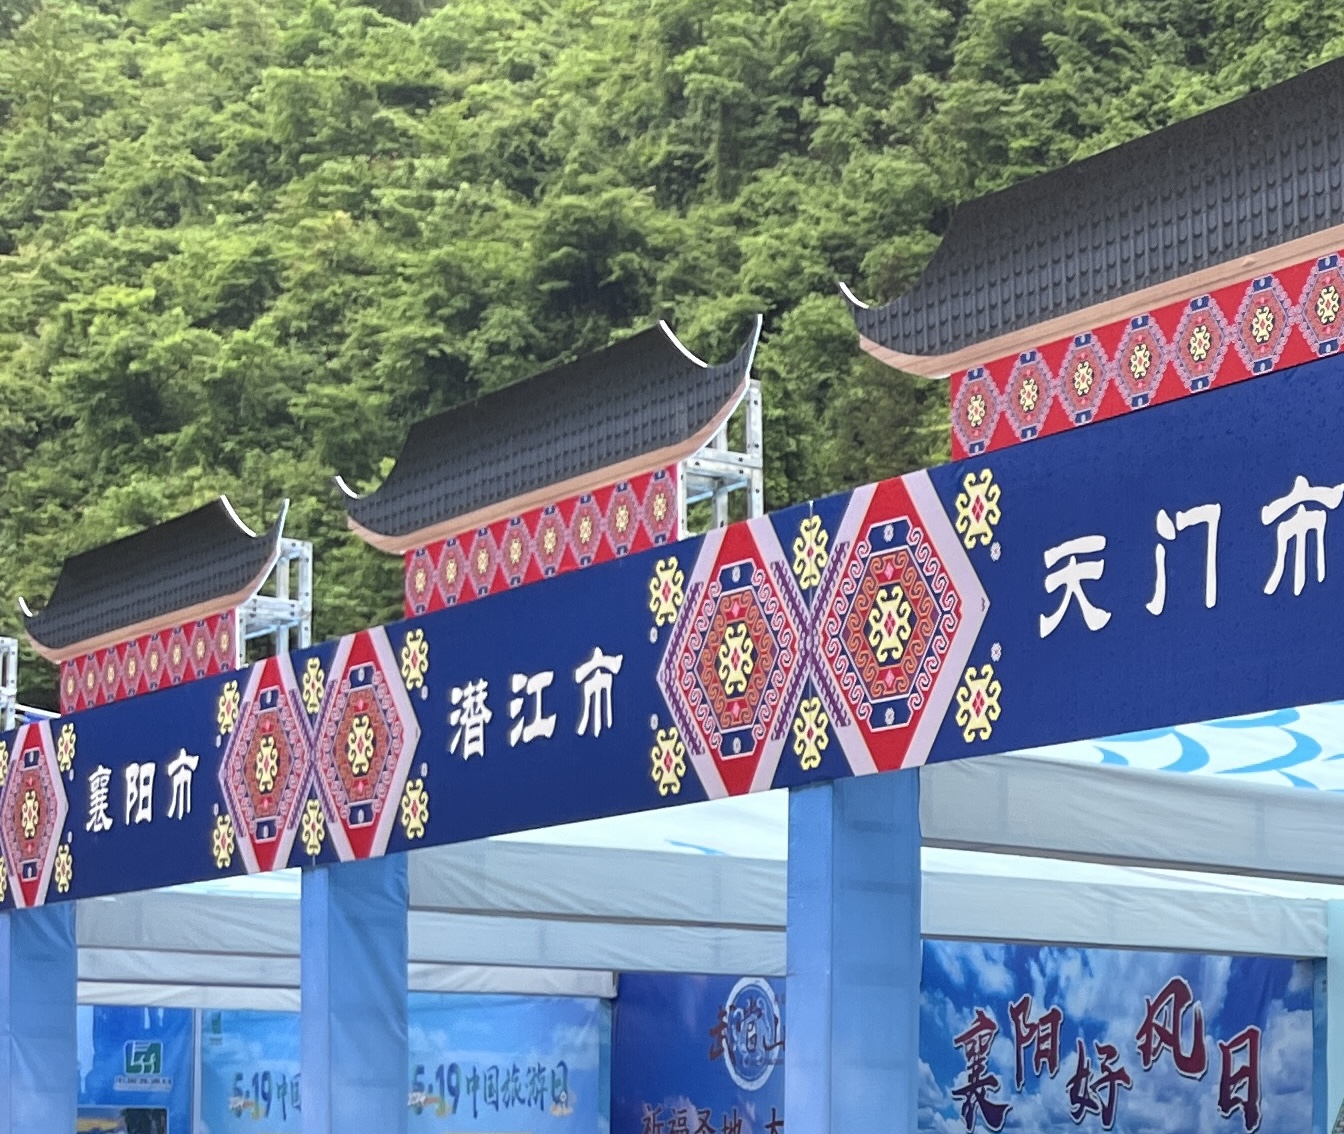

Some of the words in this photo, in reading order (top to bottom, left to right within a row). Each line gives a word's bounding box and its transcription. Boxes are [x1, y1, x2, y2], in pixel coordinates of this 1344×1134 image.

[449, 646, 624, 761] 潜江市
[86, 747, 200, 833] 襄阳市
